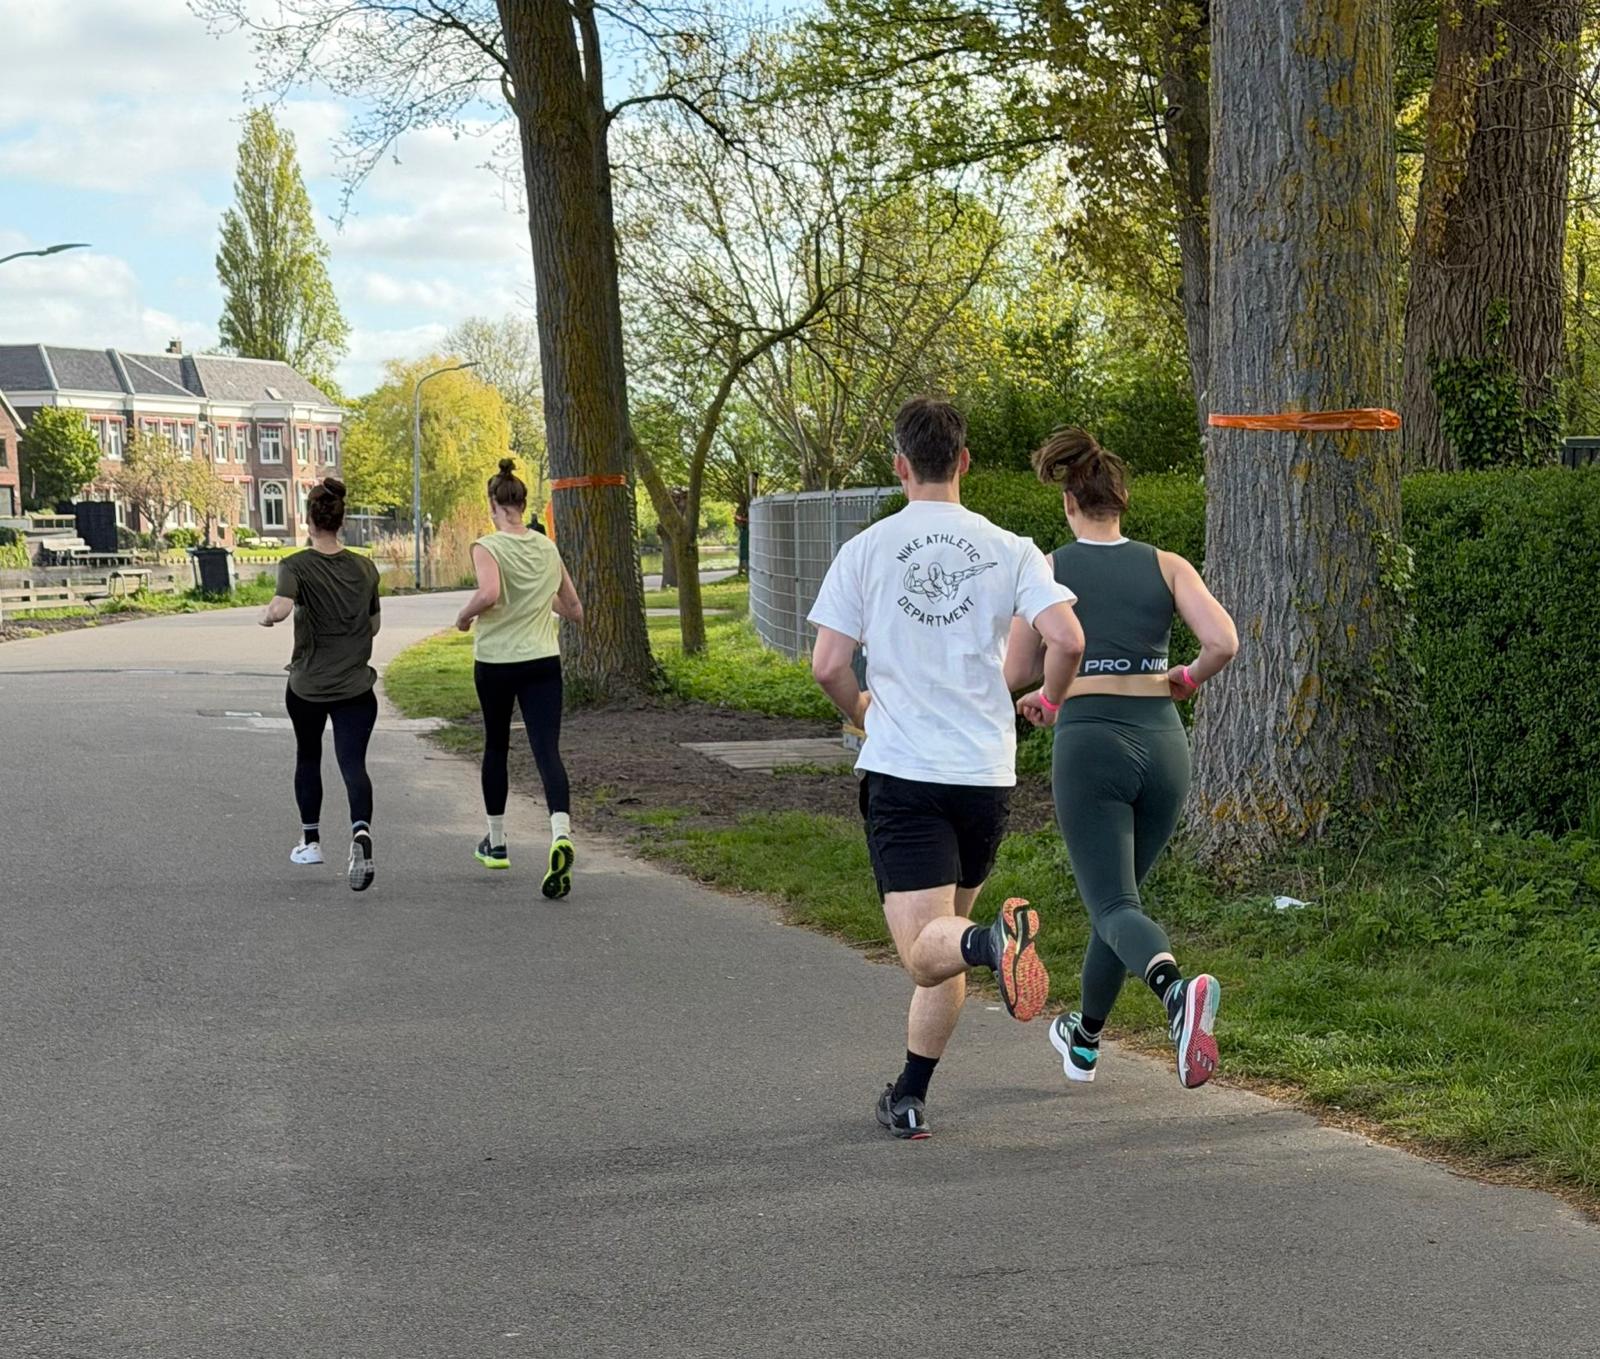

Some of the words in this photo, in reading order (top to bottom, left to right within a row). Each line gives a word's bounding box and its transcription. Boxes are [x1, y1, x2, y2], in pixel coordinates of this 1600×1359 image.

[896, 538, 923, 563] NIKE
[926, 533, 981, 562] ATHLETIC
[897, 596, 975, 627] DEPARTMENT
[1084, 658, 1131, 673] PRO
[1140, 658, 1168, 671] NIK
